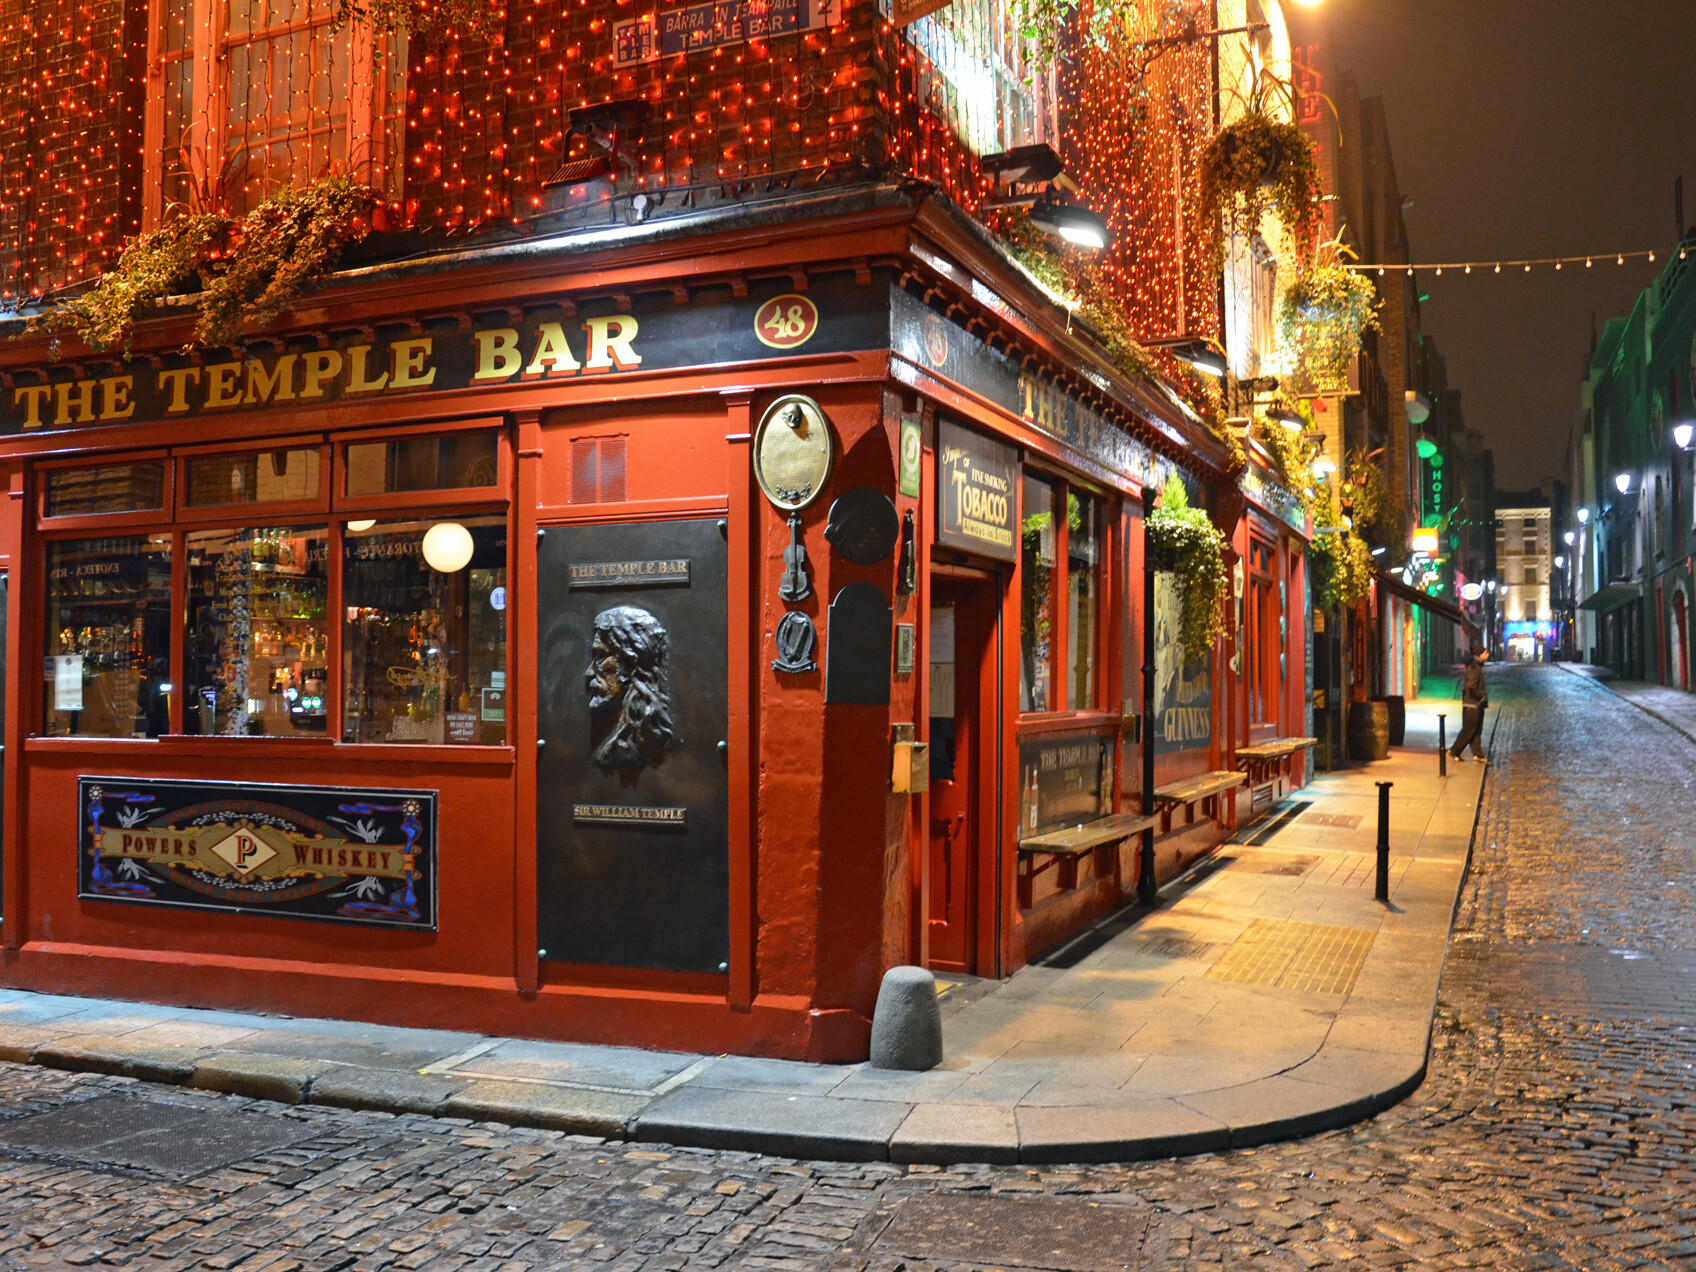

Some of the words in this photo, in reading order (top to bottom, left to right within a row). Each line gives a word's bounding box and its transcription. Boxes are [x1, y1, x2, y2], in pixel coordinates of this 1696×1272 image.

[818, 0, 832, 15] 2
[666, 12, 704, 33] BARRA
[679, 22, 741, 49] TEMPLE
[750, 16, 783, 36] BAR
[620, 46, 649, 61] BAR
[764, 305, 805, 339] 48
[12, 375, 136, 429] THE
[157, 337, 437, 413] TEMPLE
[472, 314, 642, 381] BAR
[972, 468, 985, 485] FINE
[984, 473, 1008, 492] SMOKING
[952, 469, 1008, 526] TOBACCO
[569, 565, 597, 578] THE
[600, 562, 655, 577] TEMPLE
[658, 560, 688, 574] BAR
[1164, 706, 1210, 743] GUINNESS
[573, 806, 591, 816] SIR
[592, 807, 640, 818] WILLIAM
[640, 808, 685, 820] TEMPLE
[121, 833, 198, 857] POWERS
[292, 844, 392, 870] WHISKEY
[234, 834, 258, 869] P
[226, 891, 261, 902] POT
[272, 883, 322, 901] STILL
